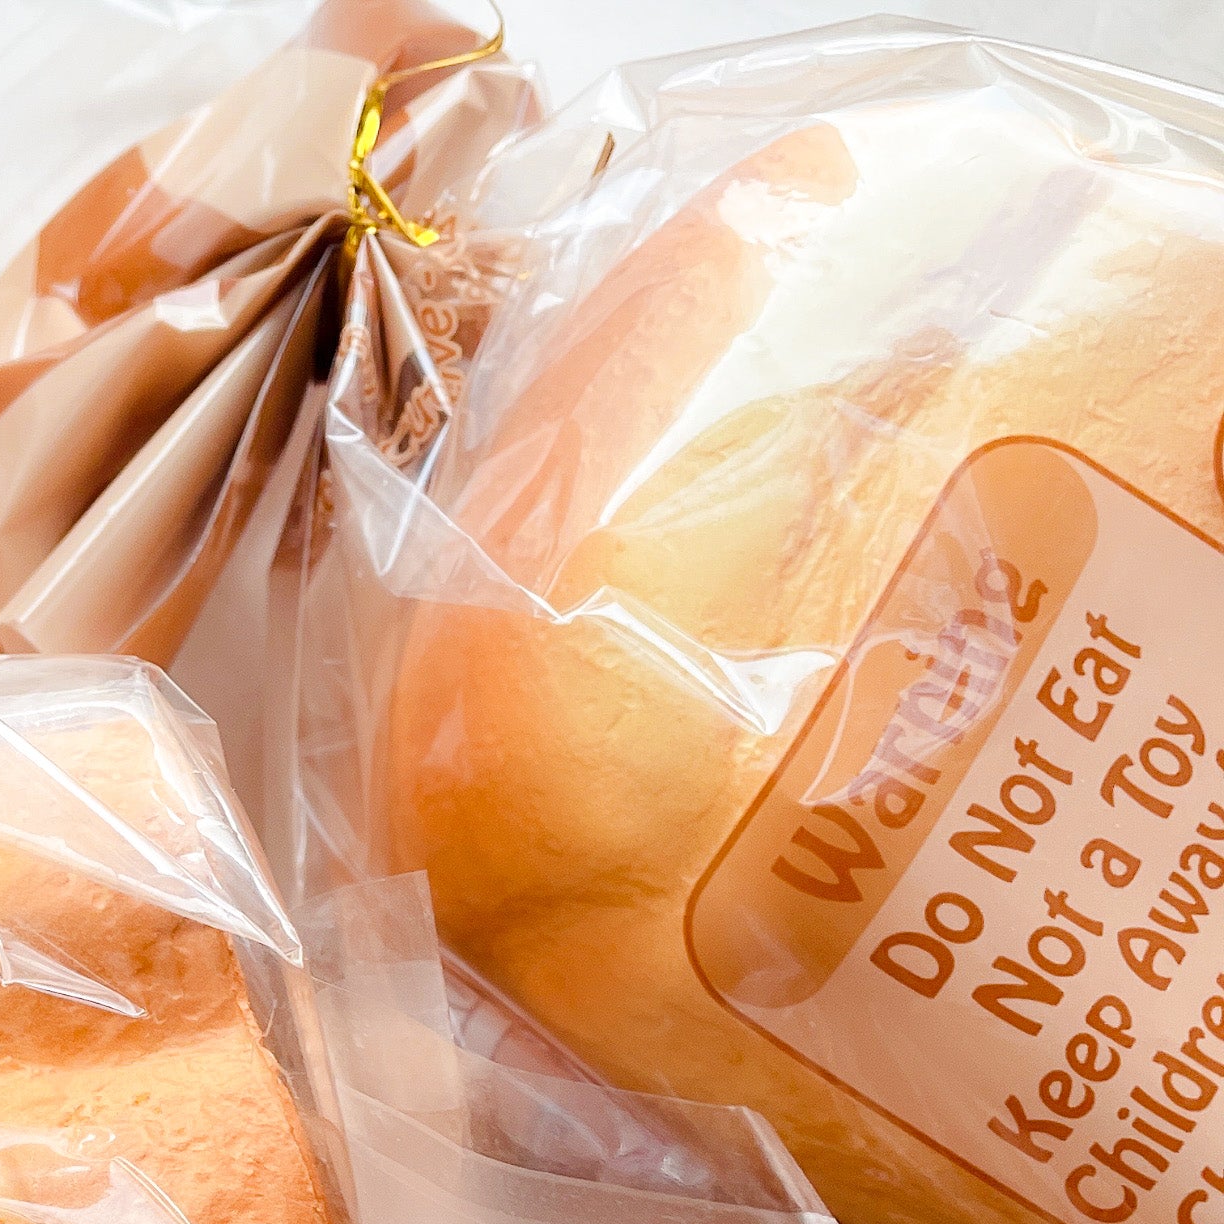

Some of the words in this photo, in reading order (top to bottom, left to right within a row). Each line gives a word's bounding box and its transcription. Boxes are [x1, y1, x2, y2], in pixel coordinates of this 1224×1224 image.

[770, 546, 1049, 903] Warning
[1100, 695, 1206, 819] Toy
[867, 891, 985, 1000] Do
[948, 736, 1073, 883] Not
[1036, 612, 1142, 742] Eat
[1080, 838, 1142, 889] a
[971, 888, 1104, 1037] Not
[985, 994, 1137, 1164] Keep
